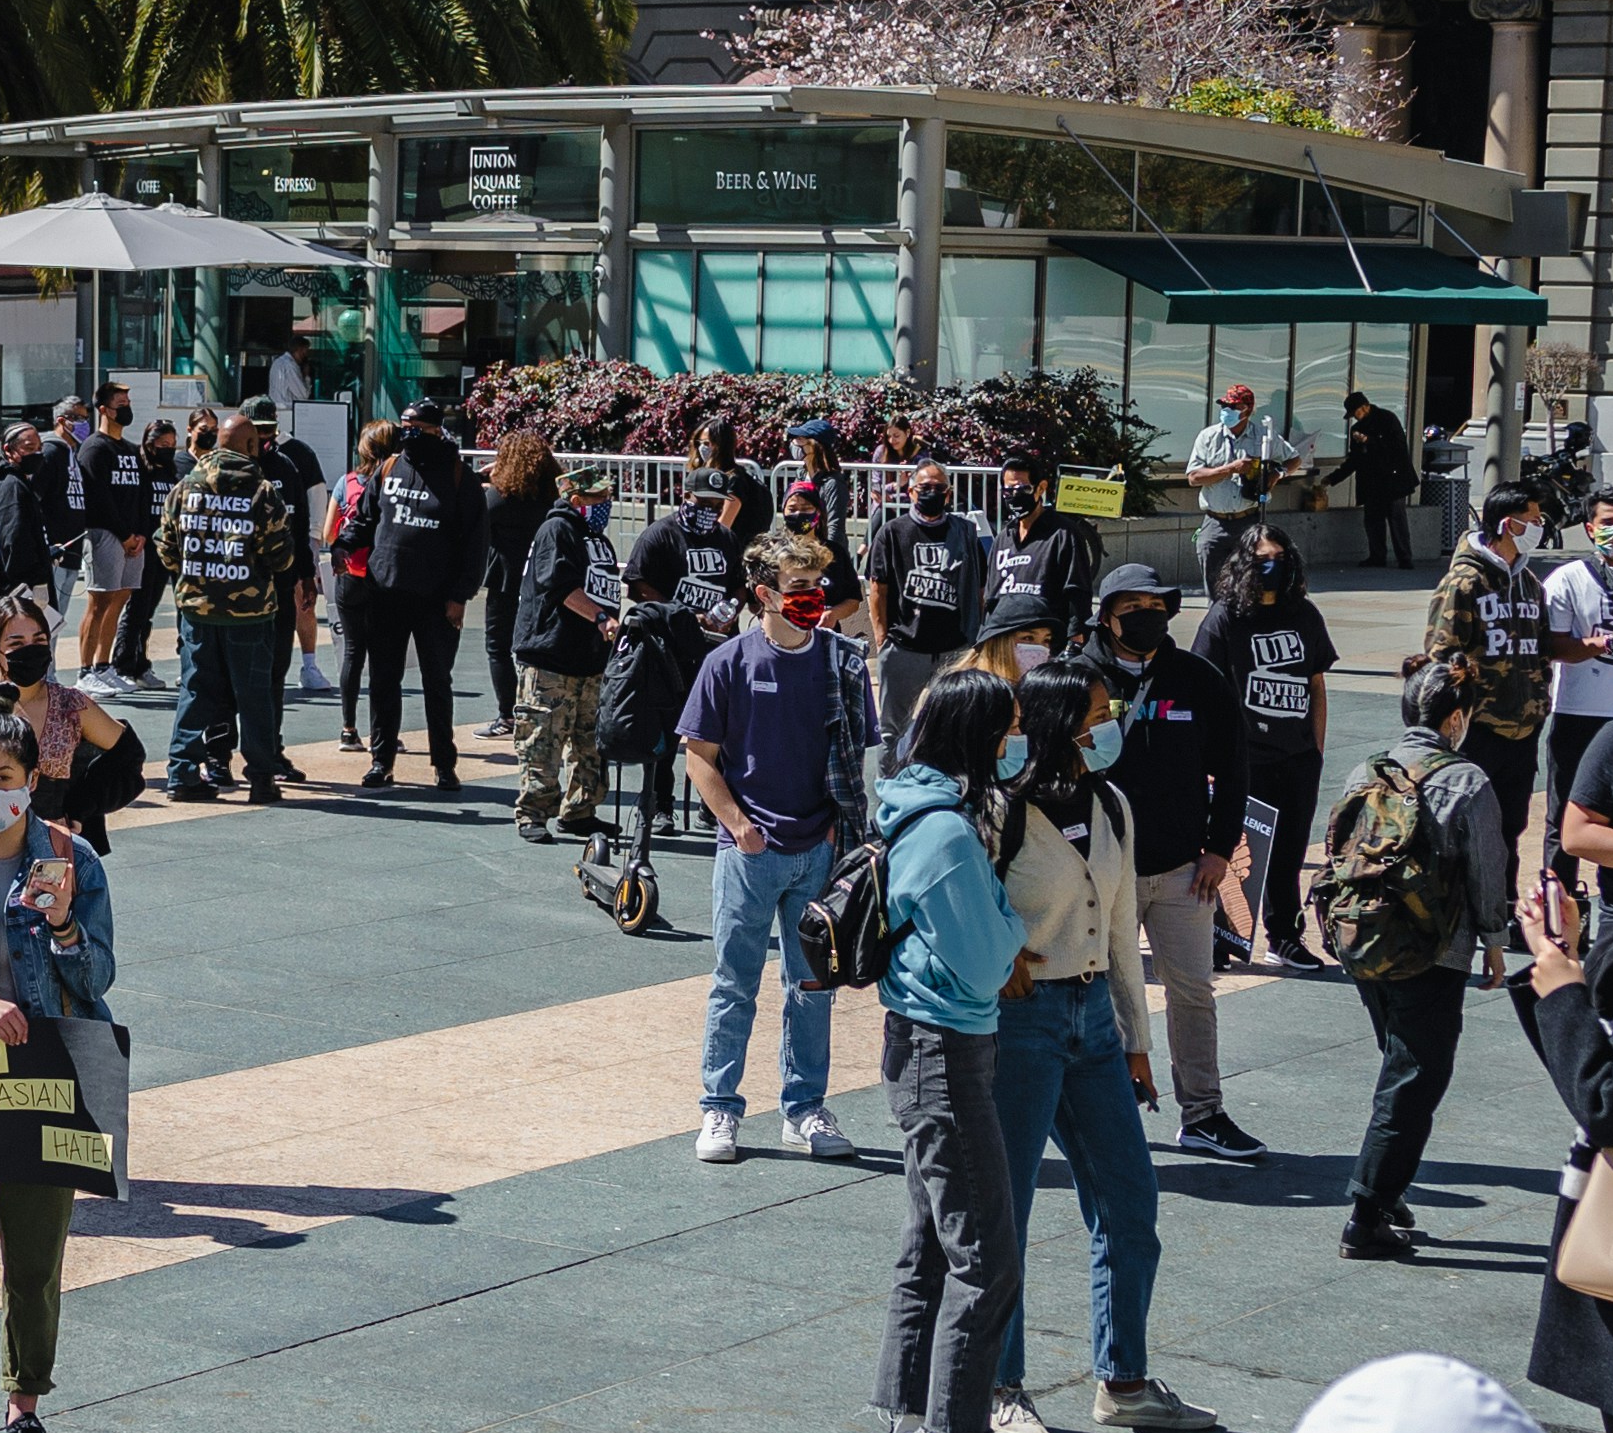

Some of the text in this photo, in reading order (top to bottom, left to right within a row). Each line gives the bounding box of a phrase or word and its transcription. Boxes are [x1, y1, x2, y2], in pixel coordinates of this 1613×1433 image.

[473, 153, 517, 169] UNION
[473, 173, 521, 192] SQUARE
[756, 170, 770, 189] &
[472, 193, 519, 210] COFFEE
[1075, 485, 1119, 496] zoomo
[187, 492, 202, 508] IT
[204, 492, 253, 513] TAKES
[180, 514, 255, 535] THE HOOD
[183, 536, 245, 558] TO SAVE
[204, 560, 251, 581] HOOD
[1252, 679, 1306, 698] UNITED
[1258, 692, 1308, 711] PLAYAZ
[1220, 927, 1252, 953] VIOLENCE
[52, 1130, 110, 1167] HATE!
